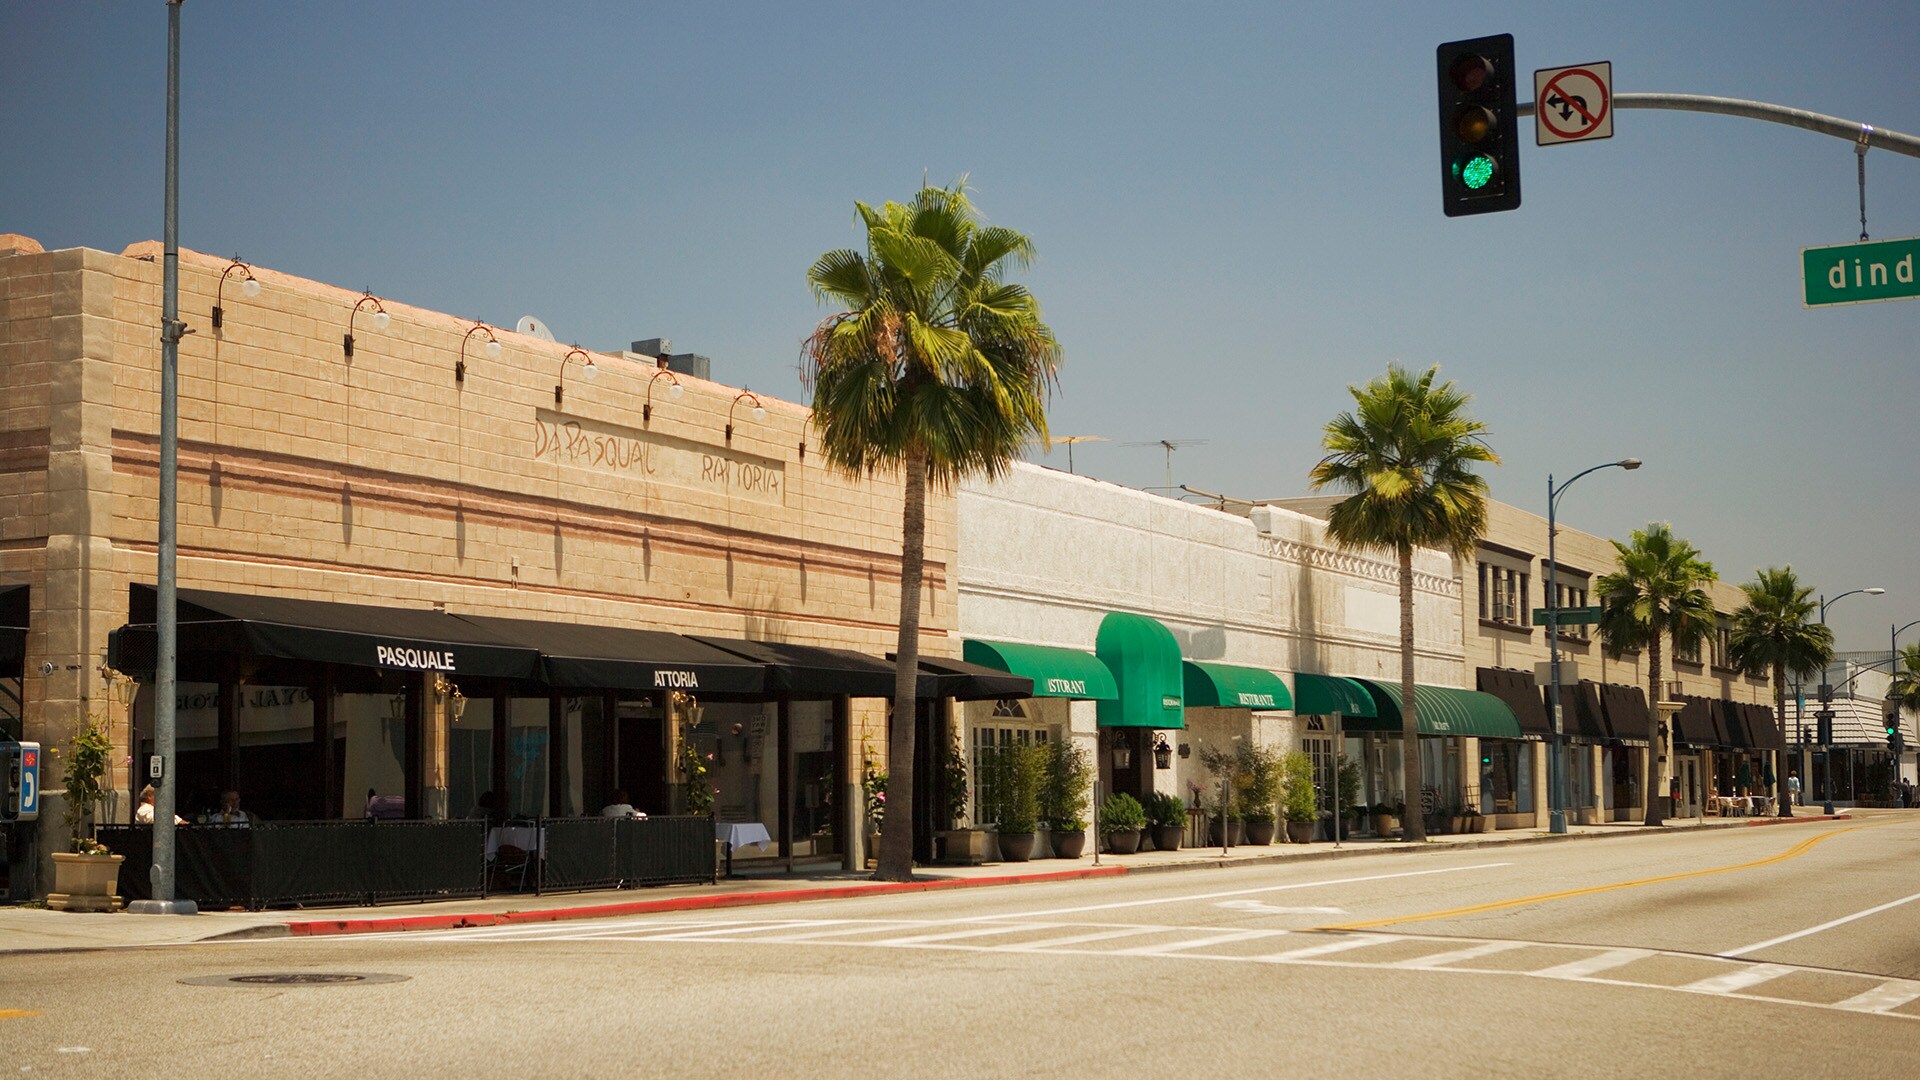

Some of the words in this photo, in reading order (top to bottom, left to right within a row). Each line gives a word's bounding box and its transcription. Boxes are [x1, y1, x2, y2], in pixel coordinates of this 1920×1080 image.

[1828, 253, 1914, 289] dind
[535, 417, 562, 458] DA
[376, 645, 456, 670] PASQUALE
[654, 670, 699, 688] ATTORIA
